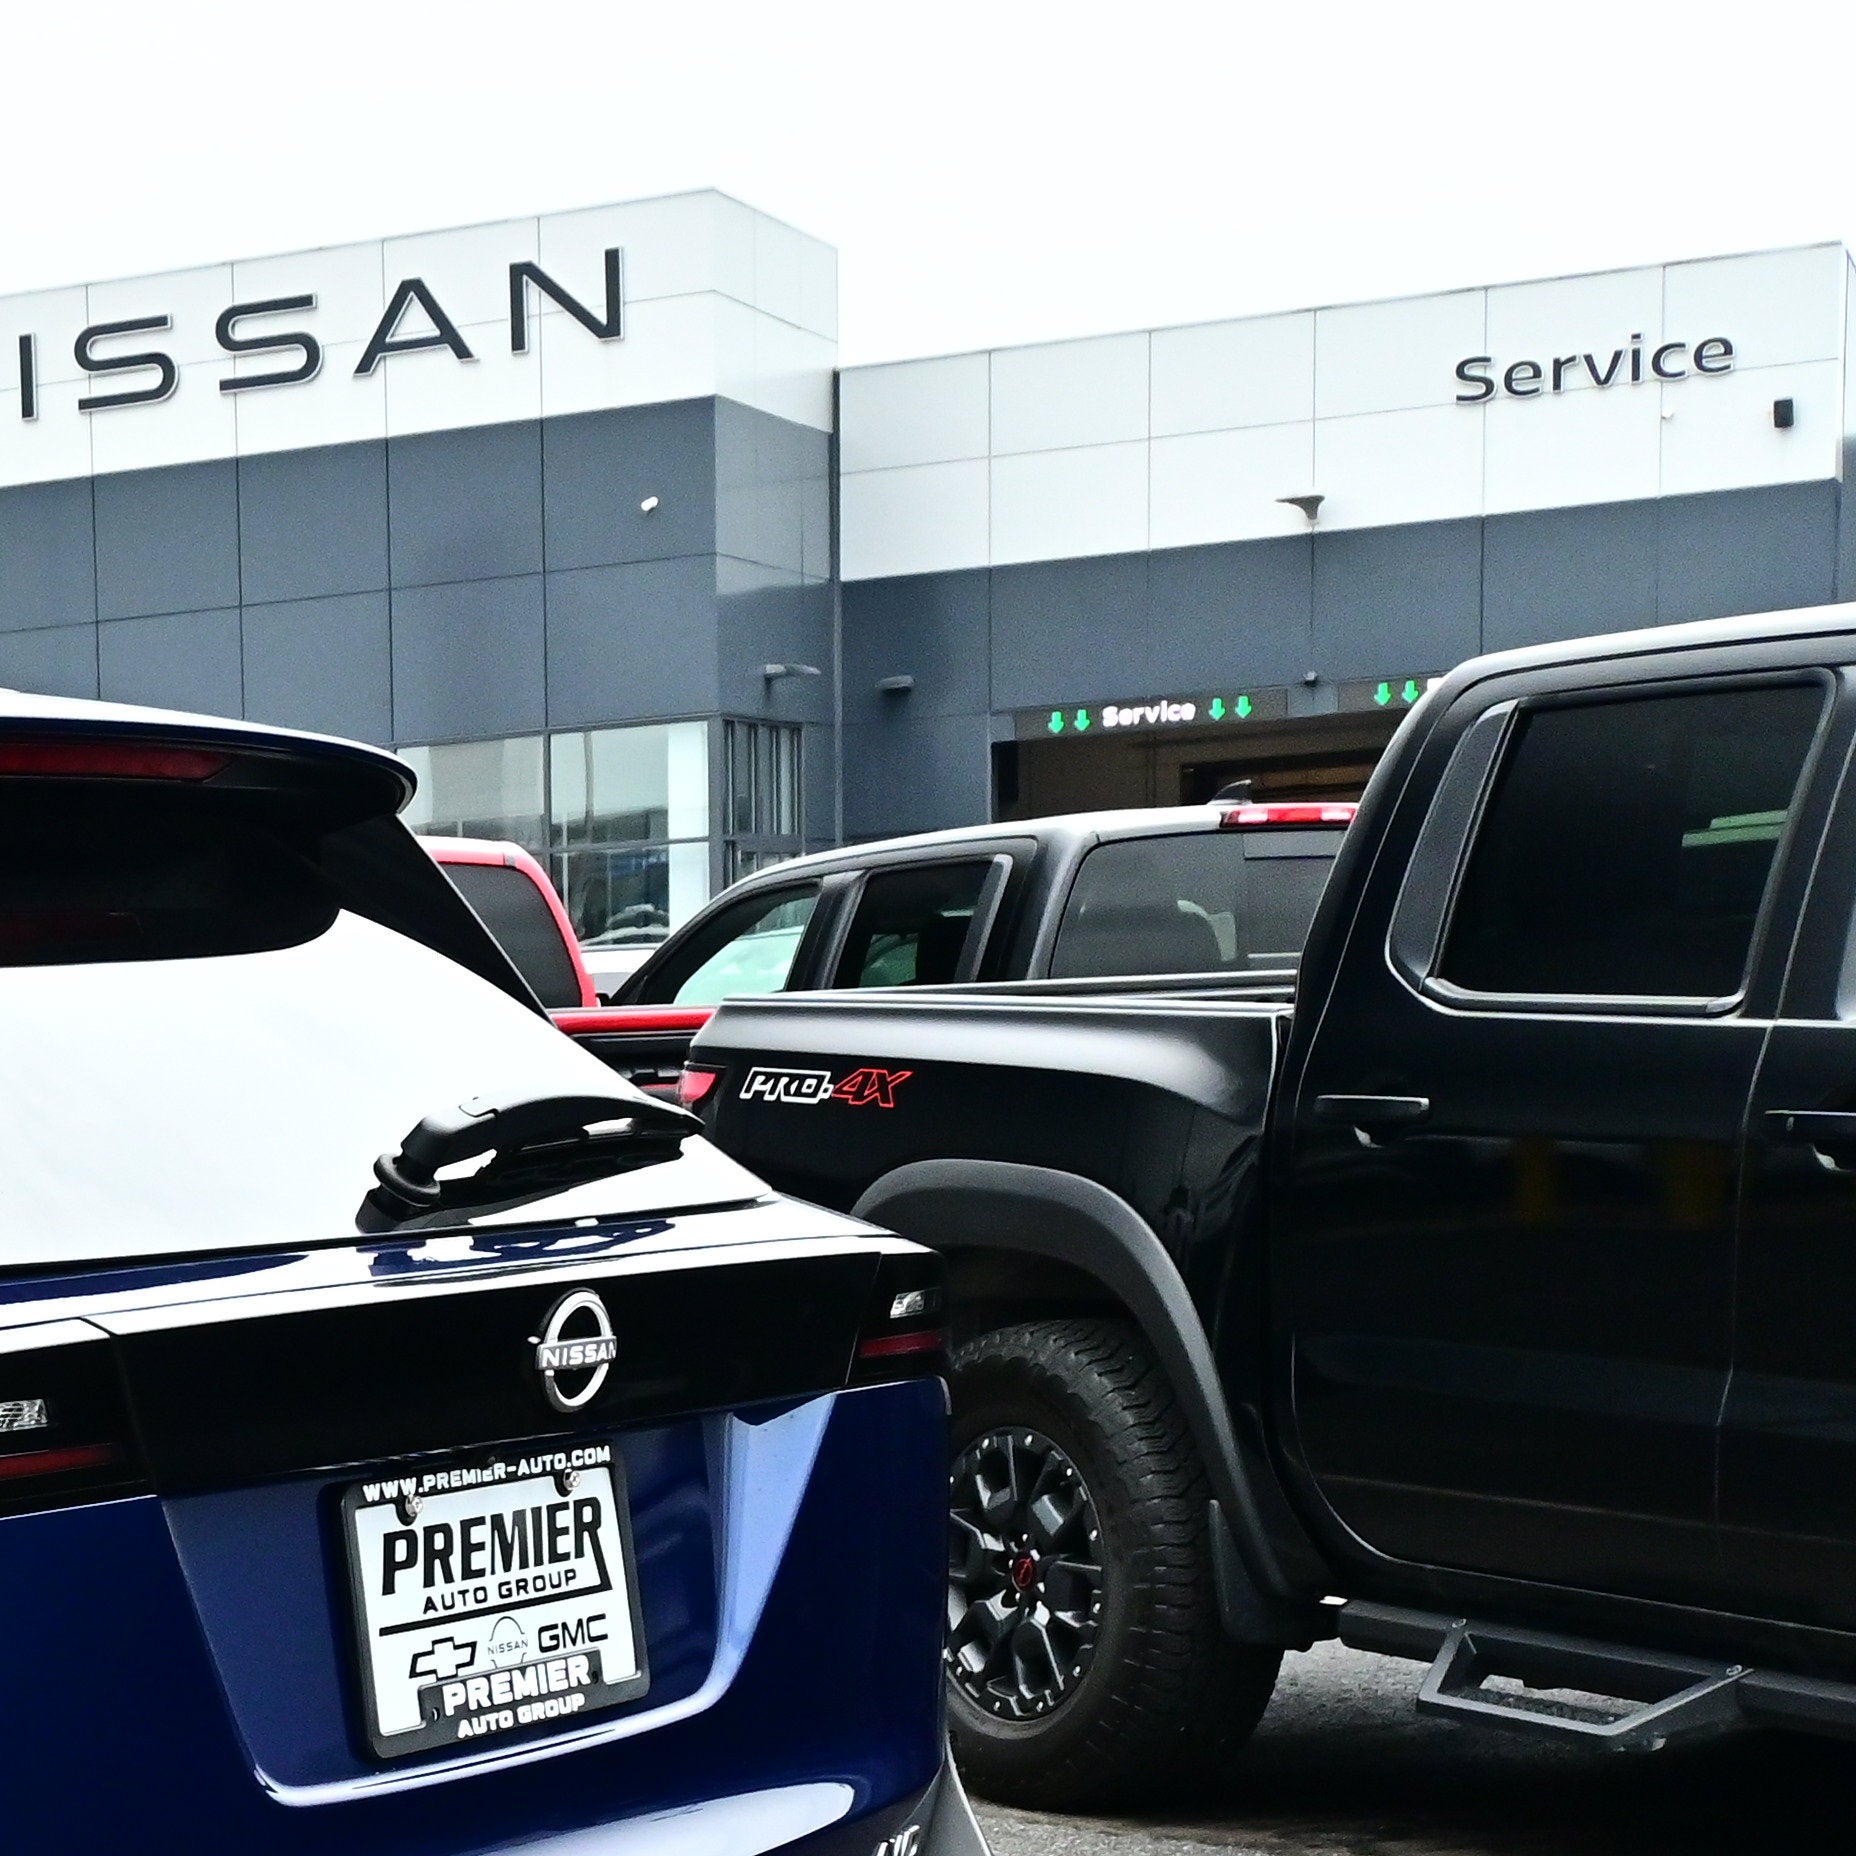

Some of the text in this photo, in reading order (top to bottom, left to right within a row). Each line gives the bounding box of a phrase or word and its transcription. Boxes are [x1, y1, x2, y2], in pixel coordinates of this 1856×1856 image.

[1455, 335, 1734, 402] Service
[1102, 700, 1196, 727] Service
[541, 1341, 616, 1368] NISSAN
[363, 1445, 611, 1502] WWW.PREMIER-AUTO.COM
[382, 1496, 613, 1596] PREMIER
[423, 1568, 577, 1614] AUTO GROUP
[487, 1613, 609, 1655] NISSAN GMC
[442, 1654, 591, 1717] PREMIER
[457, 1693, 586, 1739] AUTO GROUP
